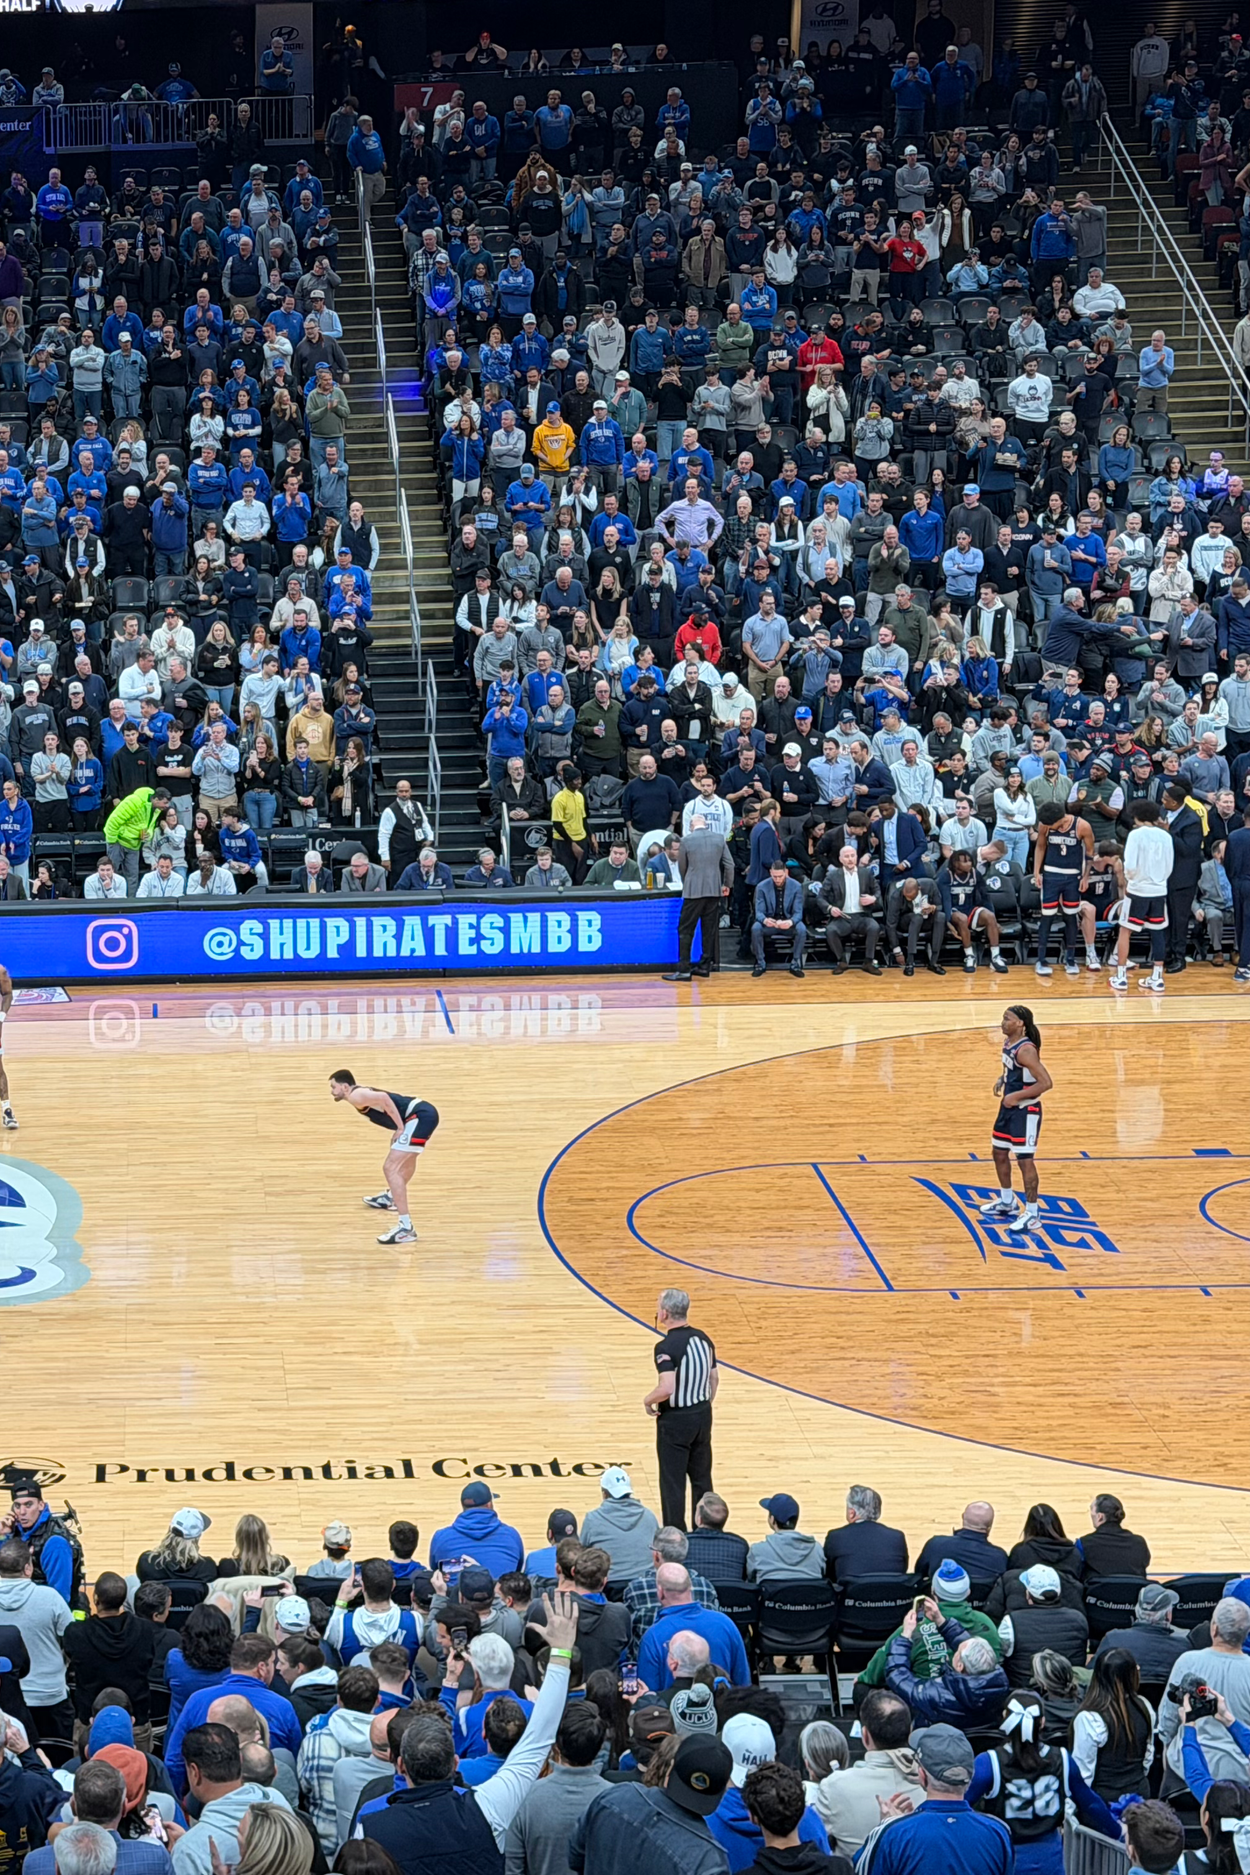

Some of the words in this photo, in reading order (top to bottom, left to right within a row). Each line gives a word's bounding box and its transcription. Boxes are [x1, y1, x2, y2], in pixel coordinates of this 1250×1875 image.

[0, 0, 41, 13] HALF
[810, 18, 849, 27] HYUNDAI
[421, 86, 434, 107] 7
[837, 210, 860, 221] UCONN
[594, 828, 628, 842] ntial
[315, 838, 346, 851] Cen
[1060, 845, 1066, 855] 3
[203, 910, 603, 961] @SHUPIRATESMBB
[88, 1457, 421, 1485] Prudential
[432, 1457, 634, 1481] Center
[732, 1604, 752, 1613] Bank
[775, 1602, 816, 1611] Columbia
[816, 1600, 835, 1610] Bank
[855, 1599, 896, 1608] Columbia
[1177, 1601, 1217, 1610] Columbia
[919, 1622, 949, 1663] JETS
